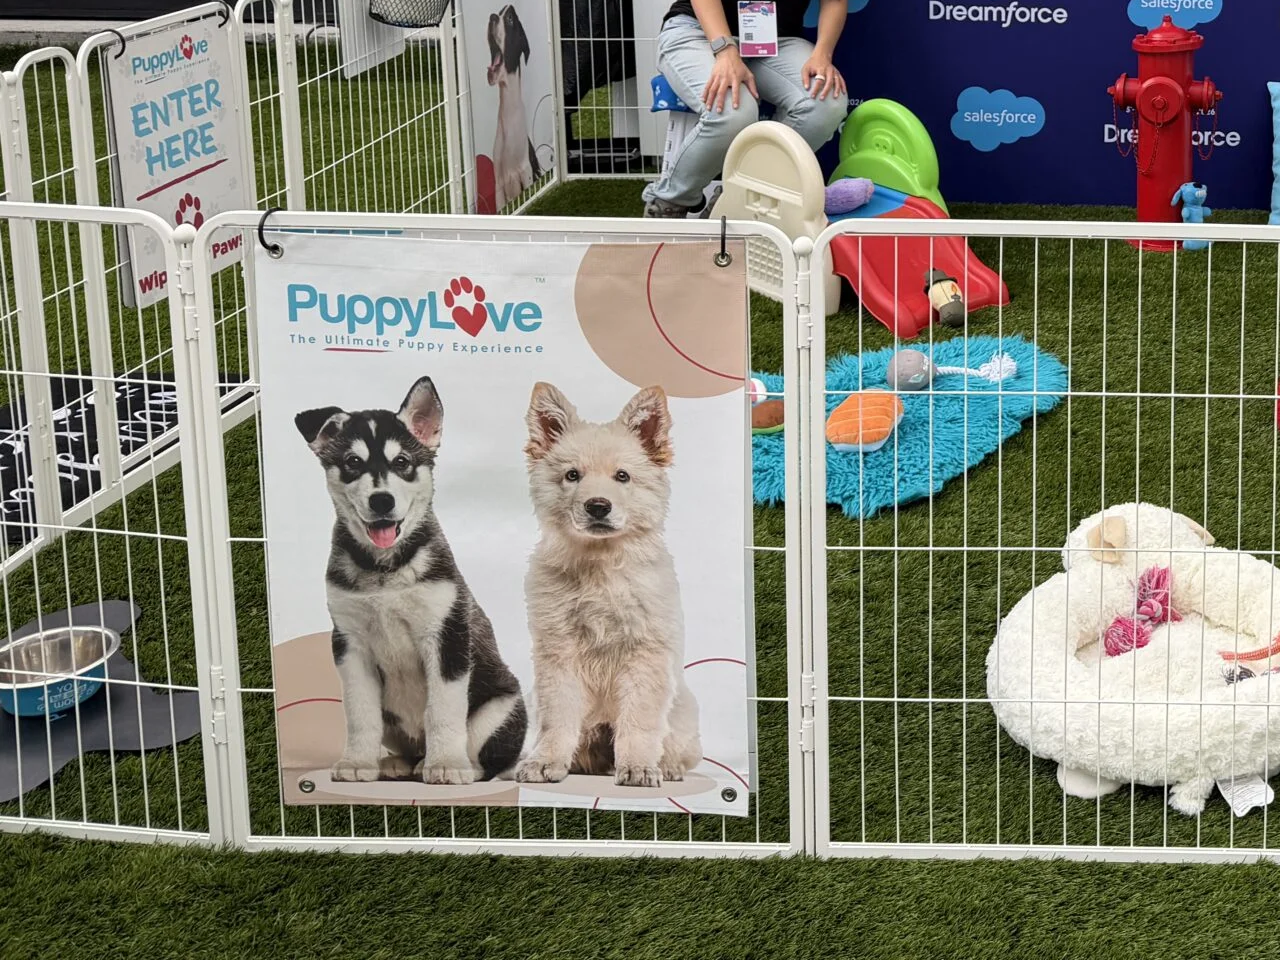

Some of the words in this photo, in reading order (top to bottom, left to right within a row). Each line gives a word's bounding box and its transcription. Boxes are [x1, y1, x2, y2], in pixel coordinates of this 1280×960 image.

[930, 1, 1067, 27] Dreamforce
[130, 78, 222, 138] ENTER
[964, 110, 1036, 126] salesforce
[1104, 124, 1241, 147] Dreorce
[145, 121, 218, 176] HERE
[290, 334, 316, 344] The
[325, 335, 390, 347] Ultimate
[398, 339, 444, 352] Puppy
[452, 342, 544, 355] Experience
